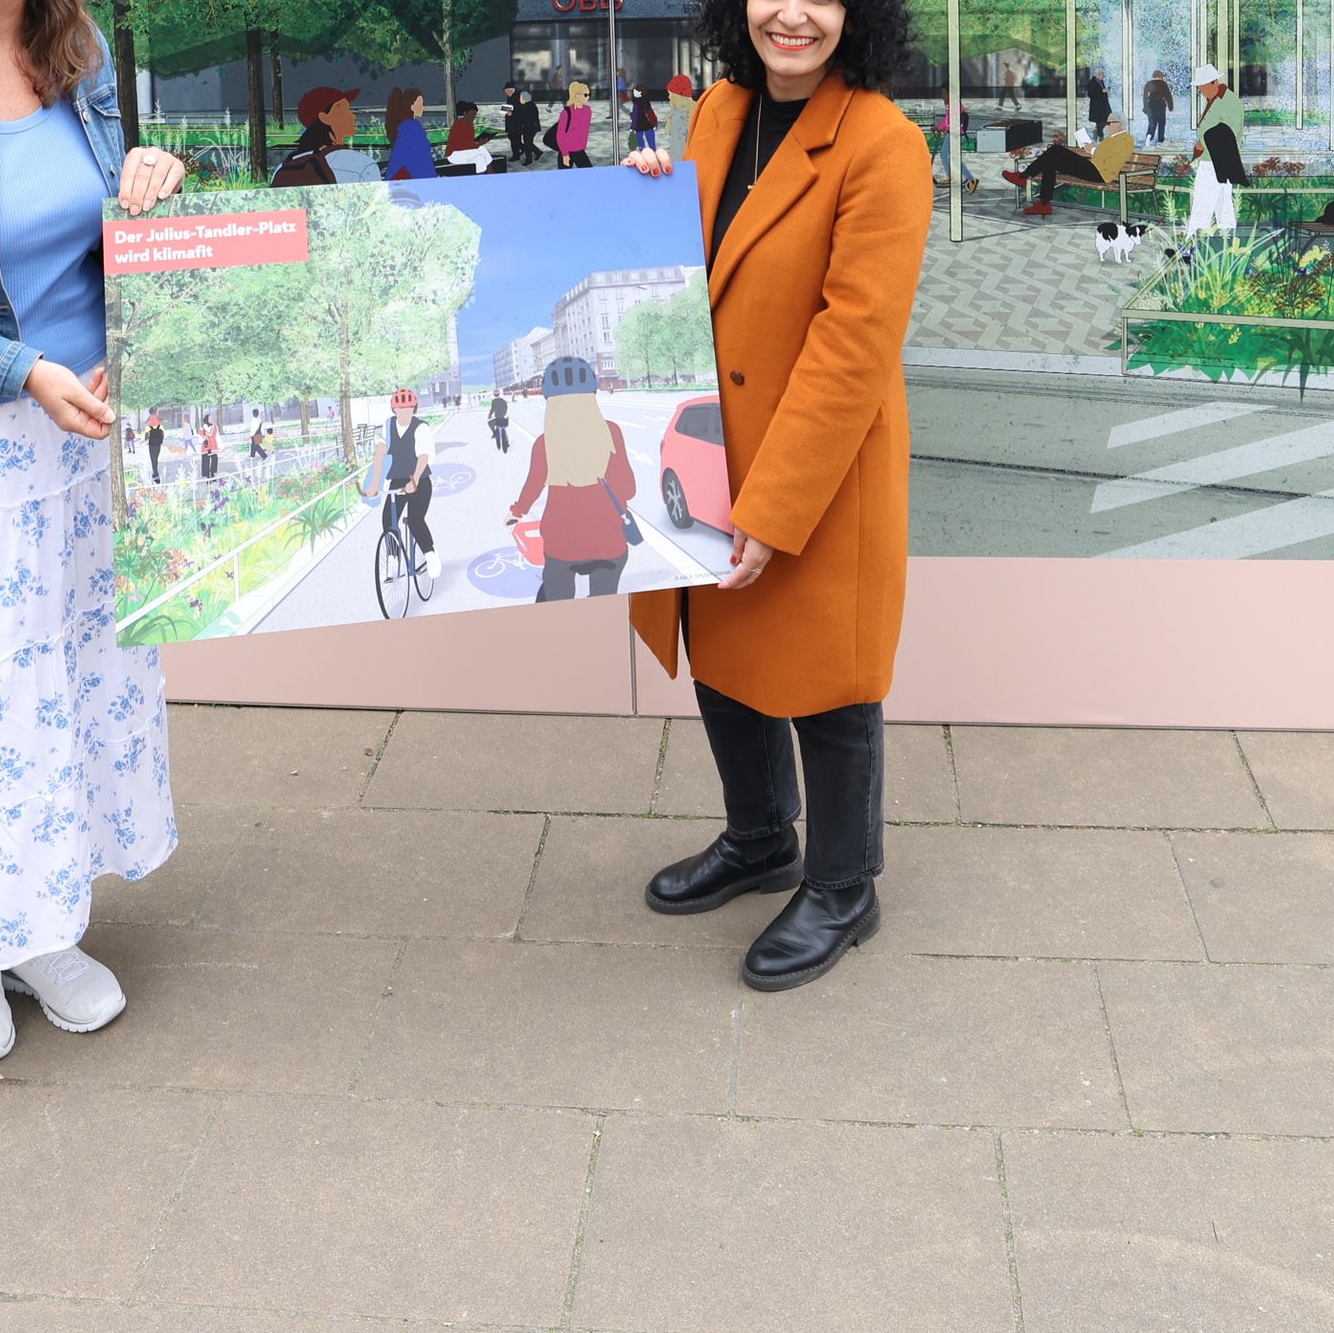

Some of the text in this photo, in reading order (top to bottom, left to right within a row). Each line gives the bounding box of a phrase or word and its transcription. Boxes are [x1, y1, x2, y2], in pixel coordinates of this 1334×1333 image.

[115, 220, 296, 244] Der Julius-Tandler-Platz
[115, 244, 213, 263] wird klimafit
